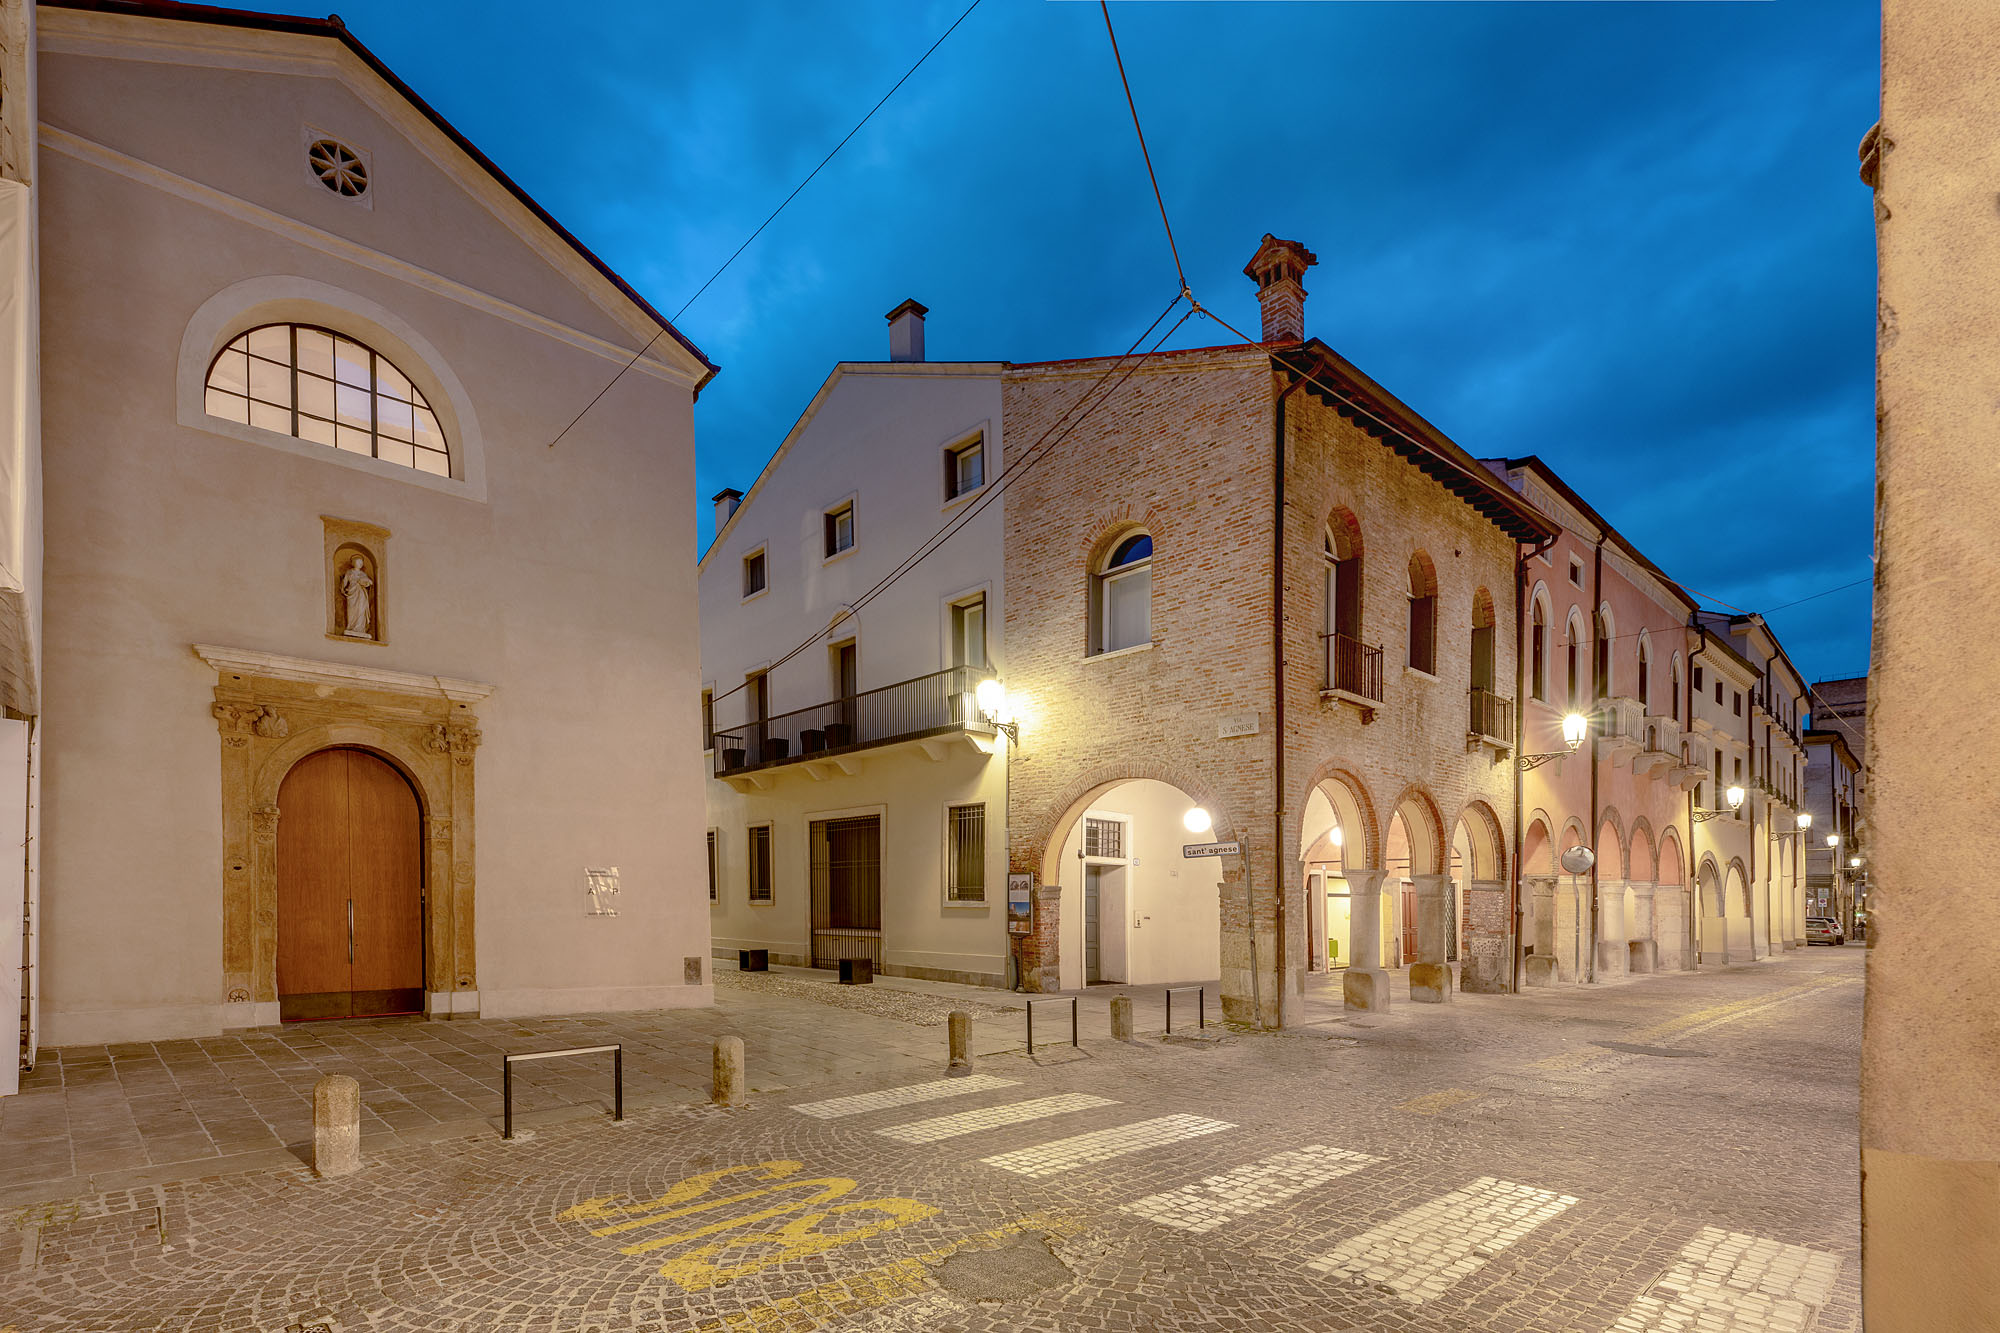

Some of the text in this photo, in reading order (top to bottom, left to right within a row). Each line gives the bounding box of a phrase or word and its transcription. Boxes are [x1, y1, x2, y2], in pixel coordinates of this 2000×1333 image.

[1229, 723, 1255, 733] AGNESE
[1187, 846, 1238, 855] sant' agnese
[556, 1160, 943, 1292] BUS
